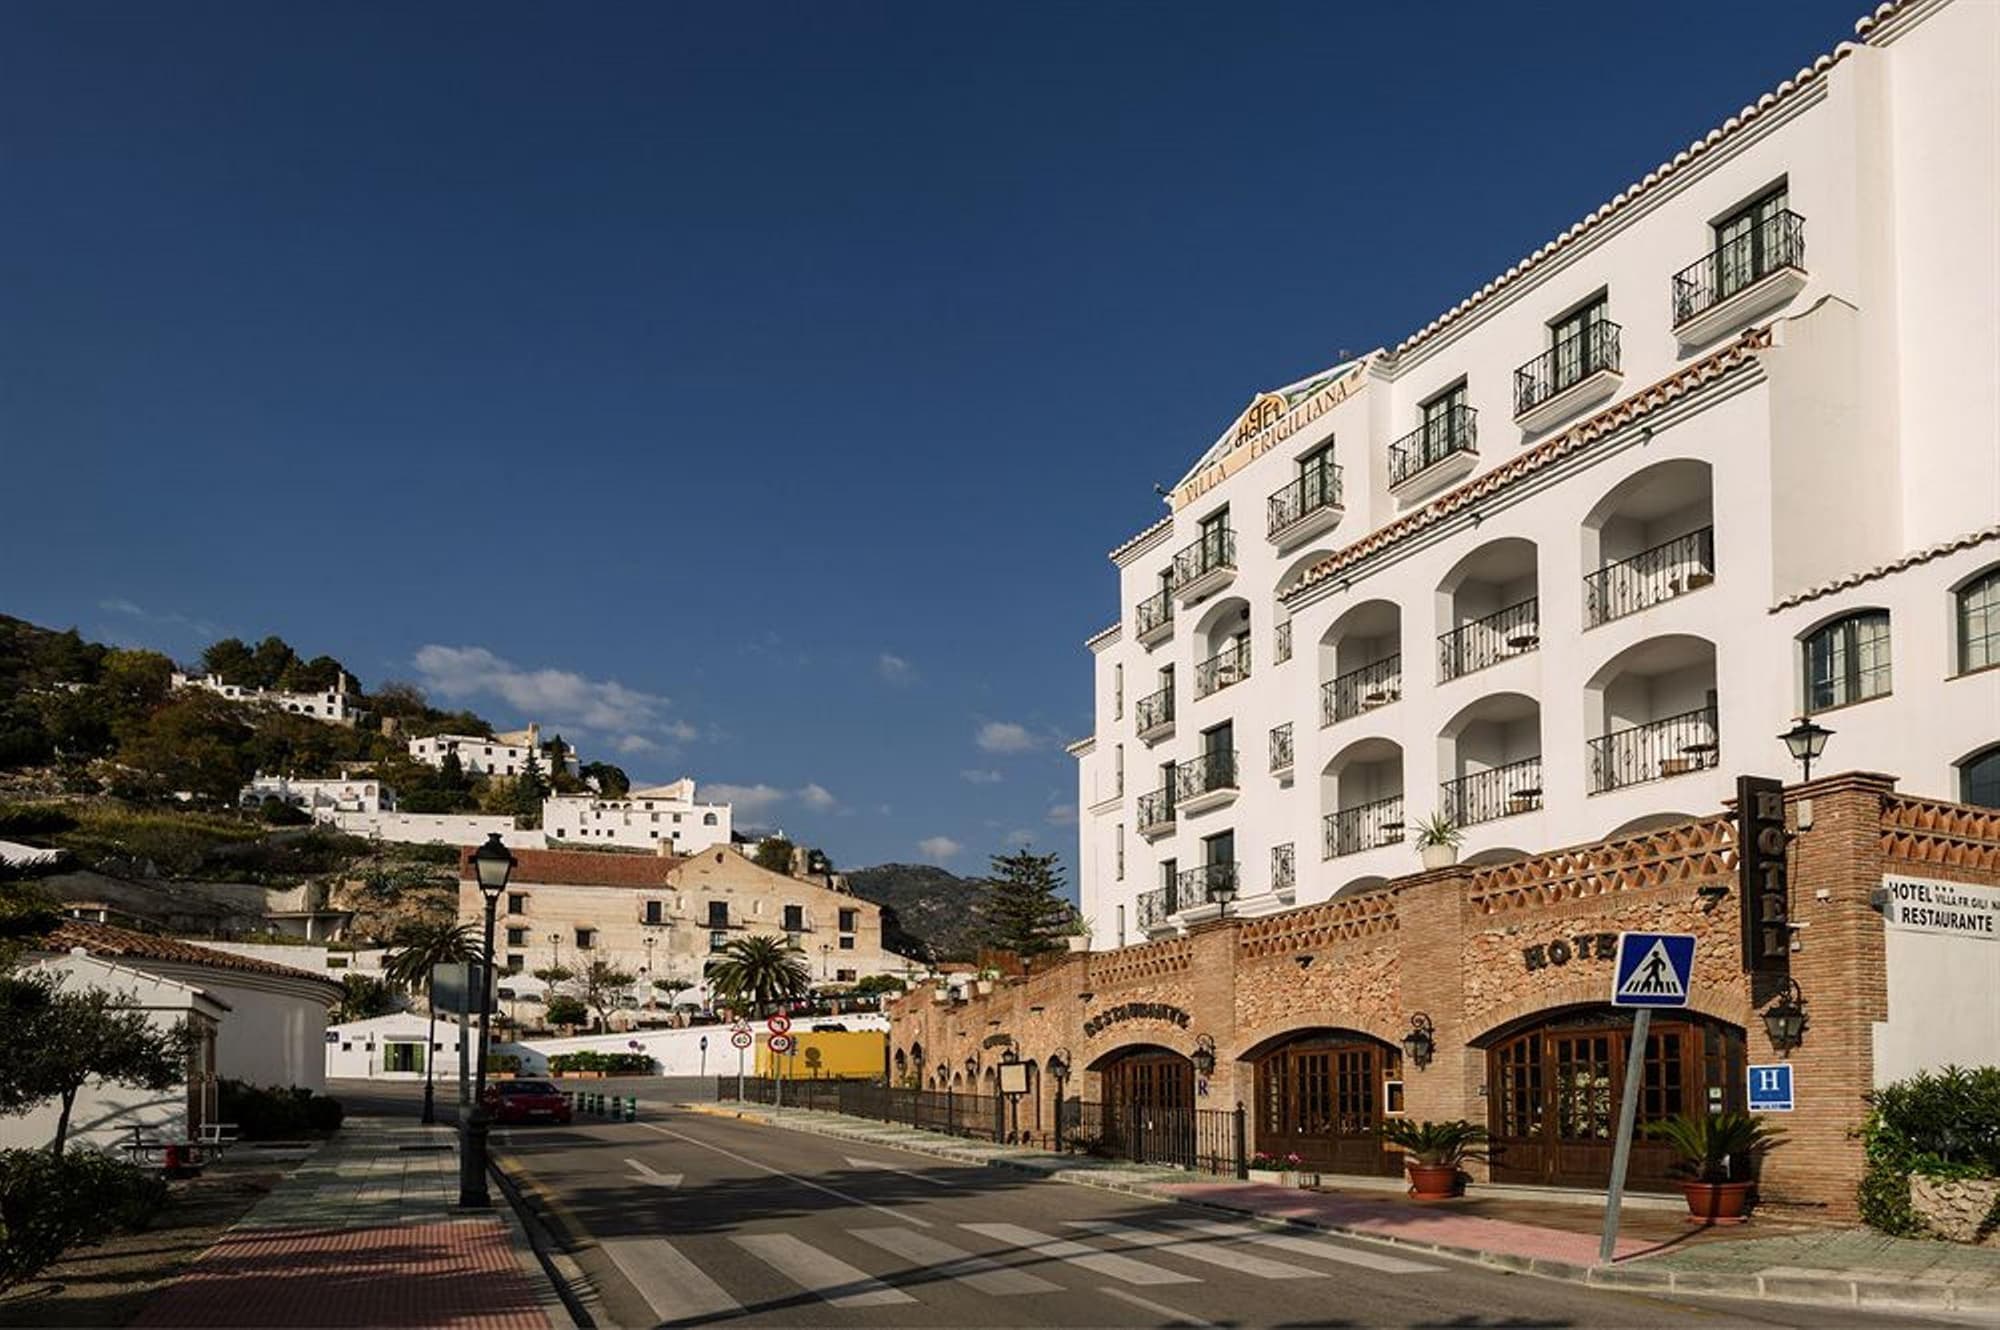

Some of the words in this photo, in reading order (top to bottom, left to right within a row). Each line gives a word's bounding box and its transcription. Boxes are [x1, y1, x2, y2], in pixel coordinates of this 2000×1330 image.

[1235, 400, 1285, 448] HOTEL
[1185, 463, 1226, 501] VILLA
[1250, 381, 1347, 459] FRIGILIANA
[1757, 791, 1786, 956] HOTEL
[1889, 882, 1933, 902] HOTEL
[1902, 907, 1993, 932] RESTAURANTE
[1522, 932, 1619, 971] HOTE
[1199, 1078, 1208, 1096] R
[1759, 1069, 1780, 1091] H
